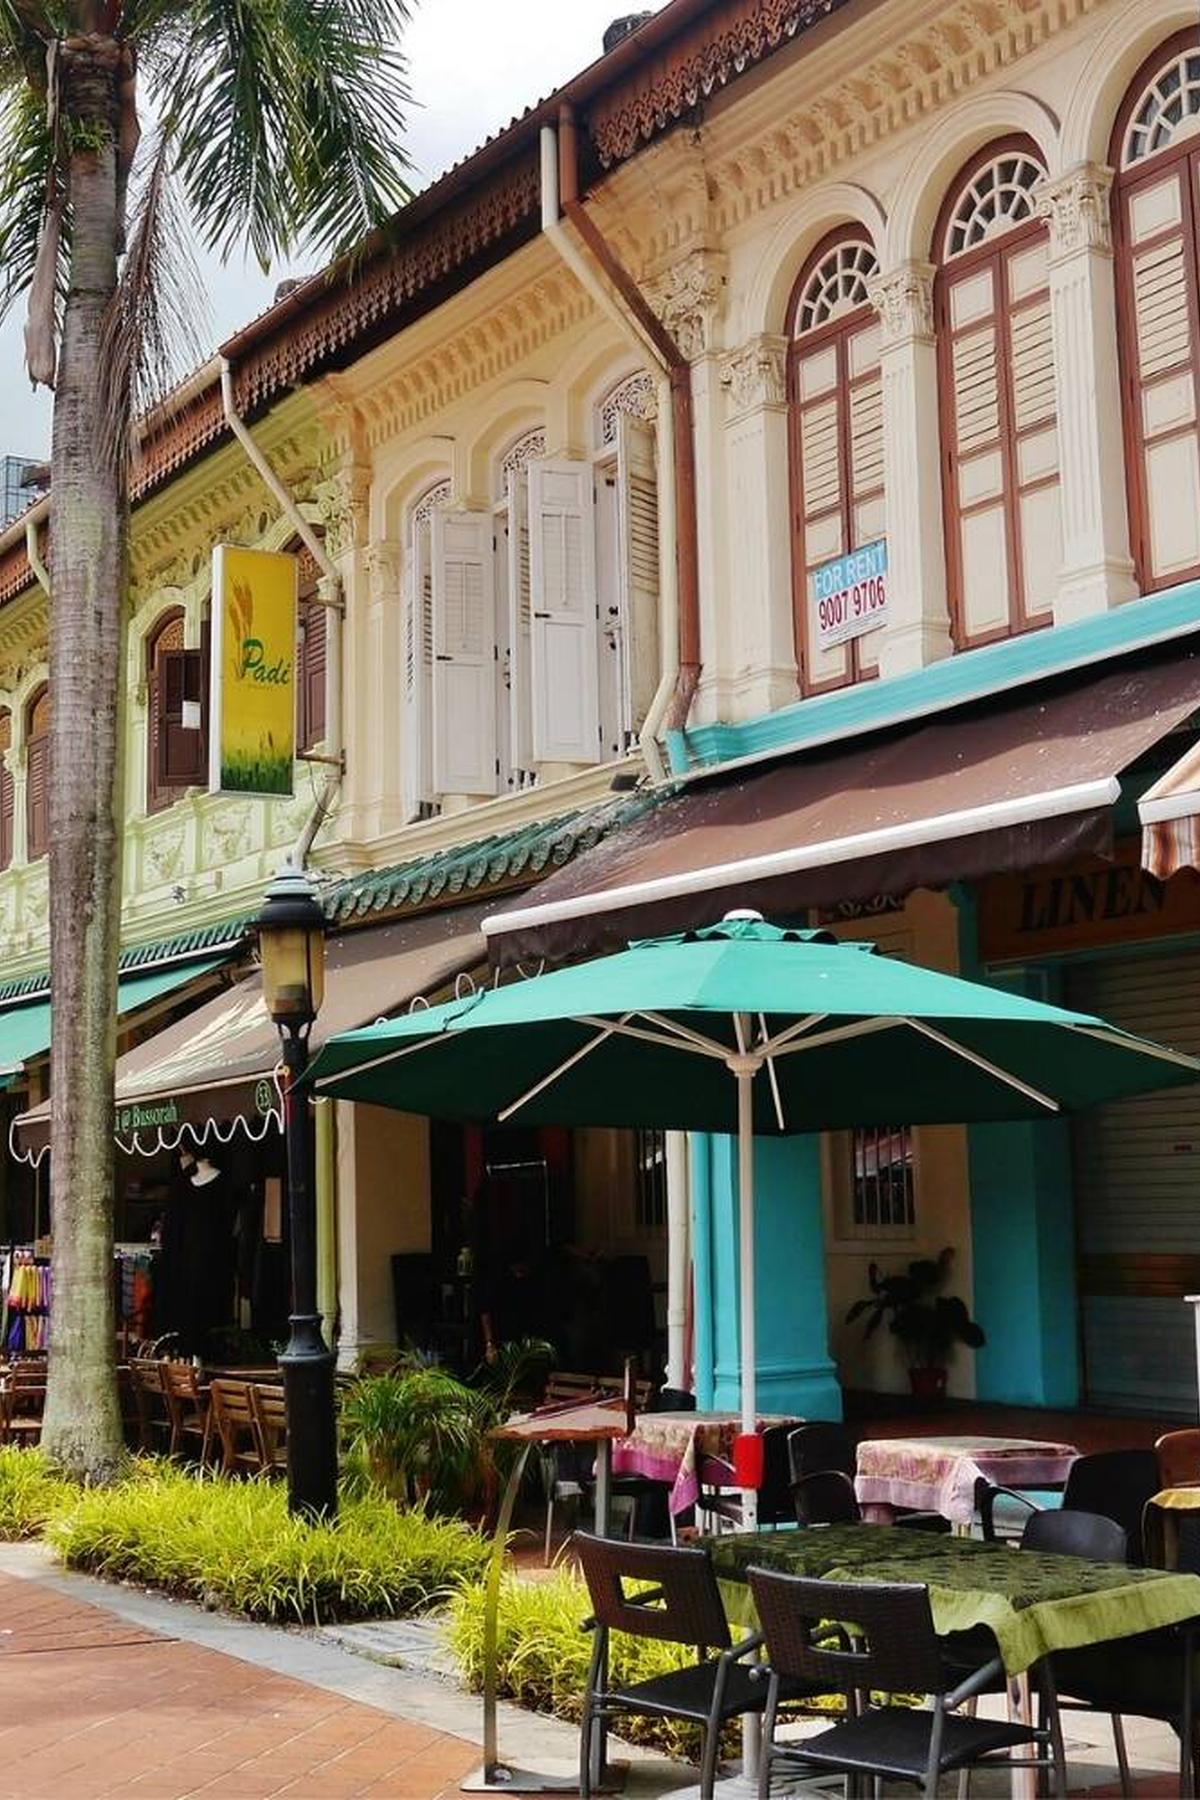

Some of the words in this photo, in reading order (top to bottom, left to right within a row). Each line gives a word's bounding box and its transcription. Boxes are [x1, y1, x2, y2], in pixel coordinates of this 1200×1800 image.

[815, 563, 843, 598] FOR
[846, 545, 886, 586] RENT
[819, 590, 849, 631] 9007
[852, 576, 886, 616] 9706
[241, 638, 291, 685] Padi
[1016, 868, 1168, 931] LINEN
